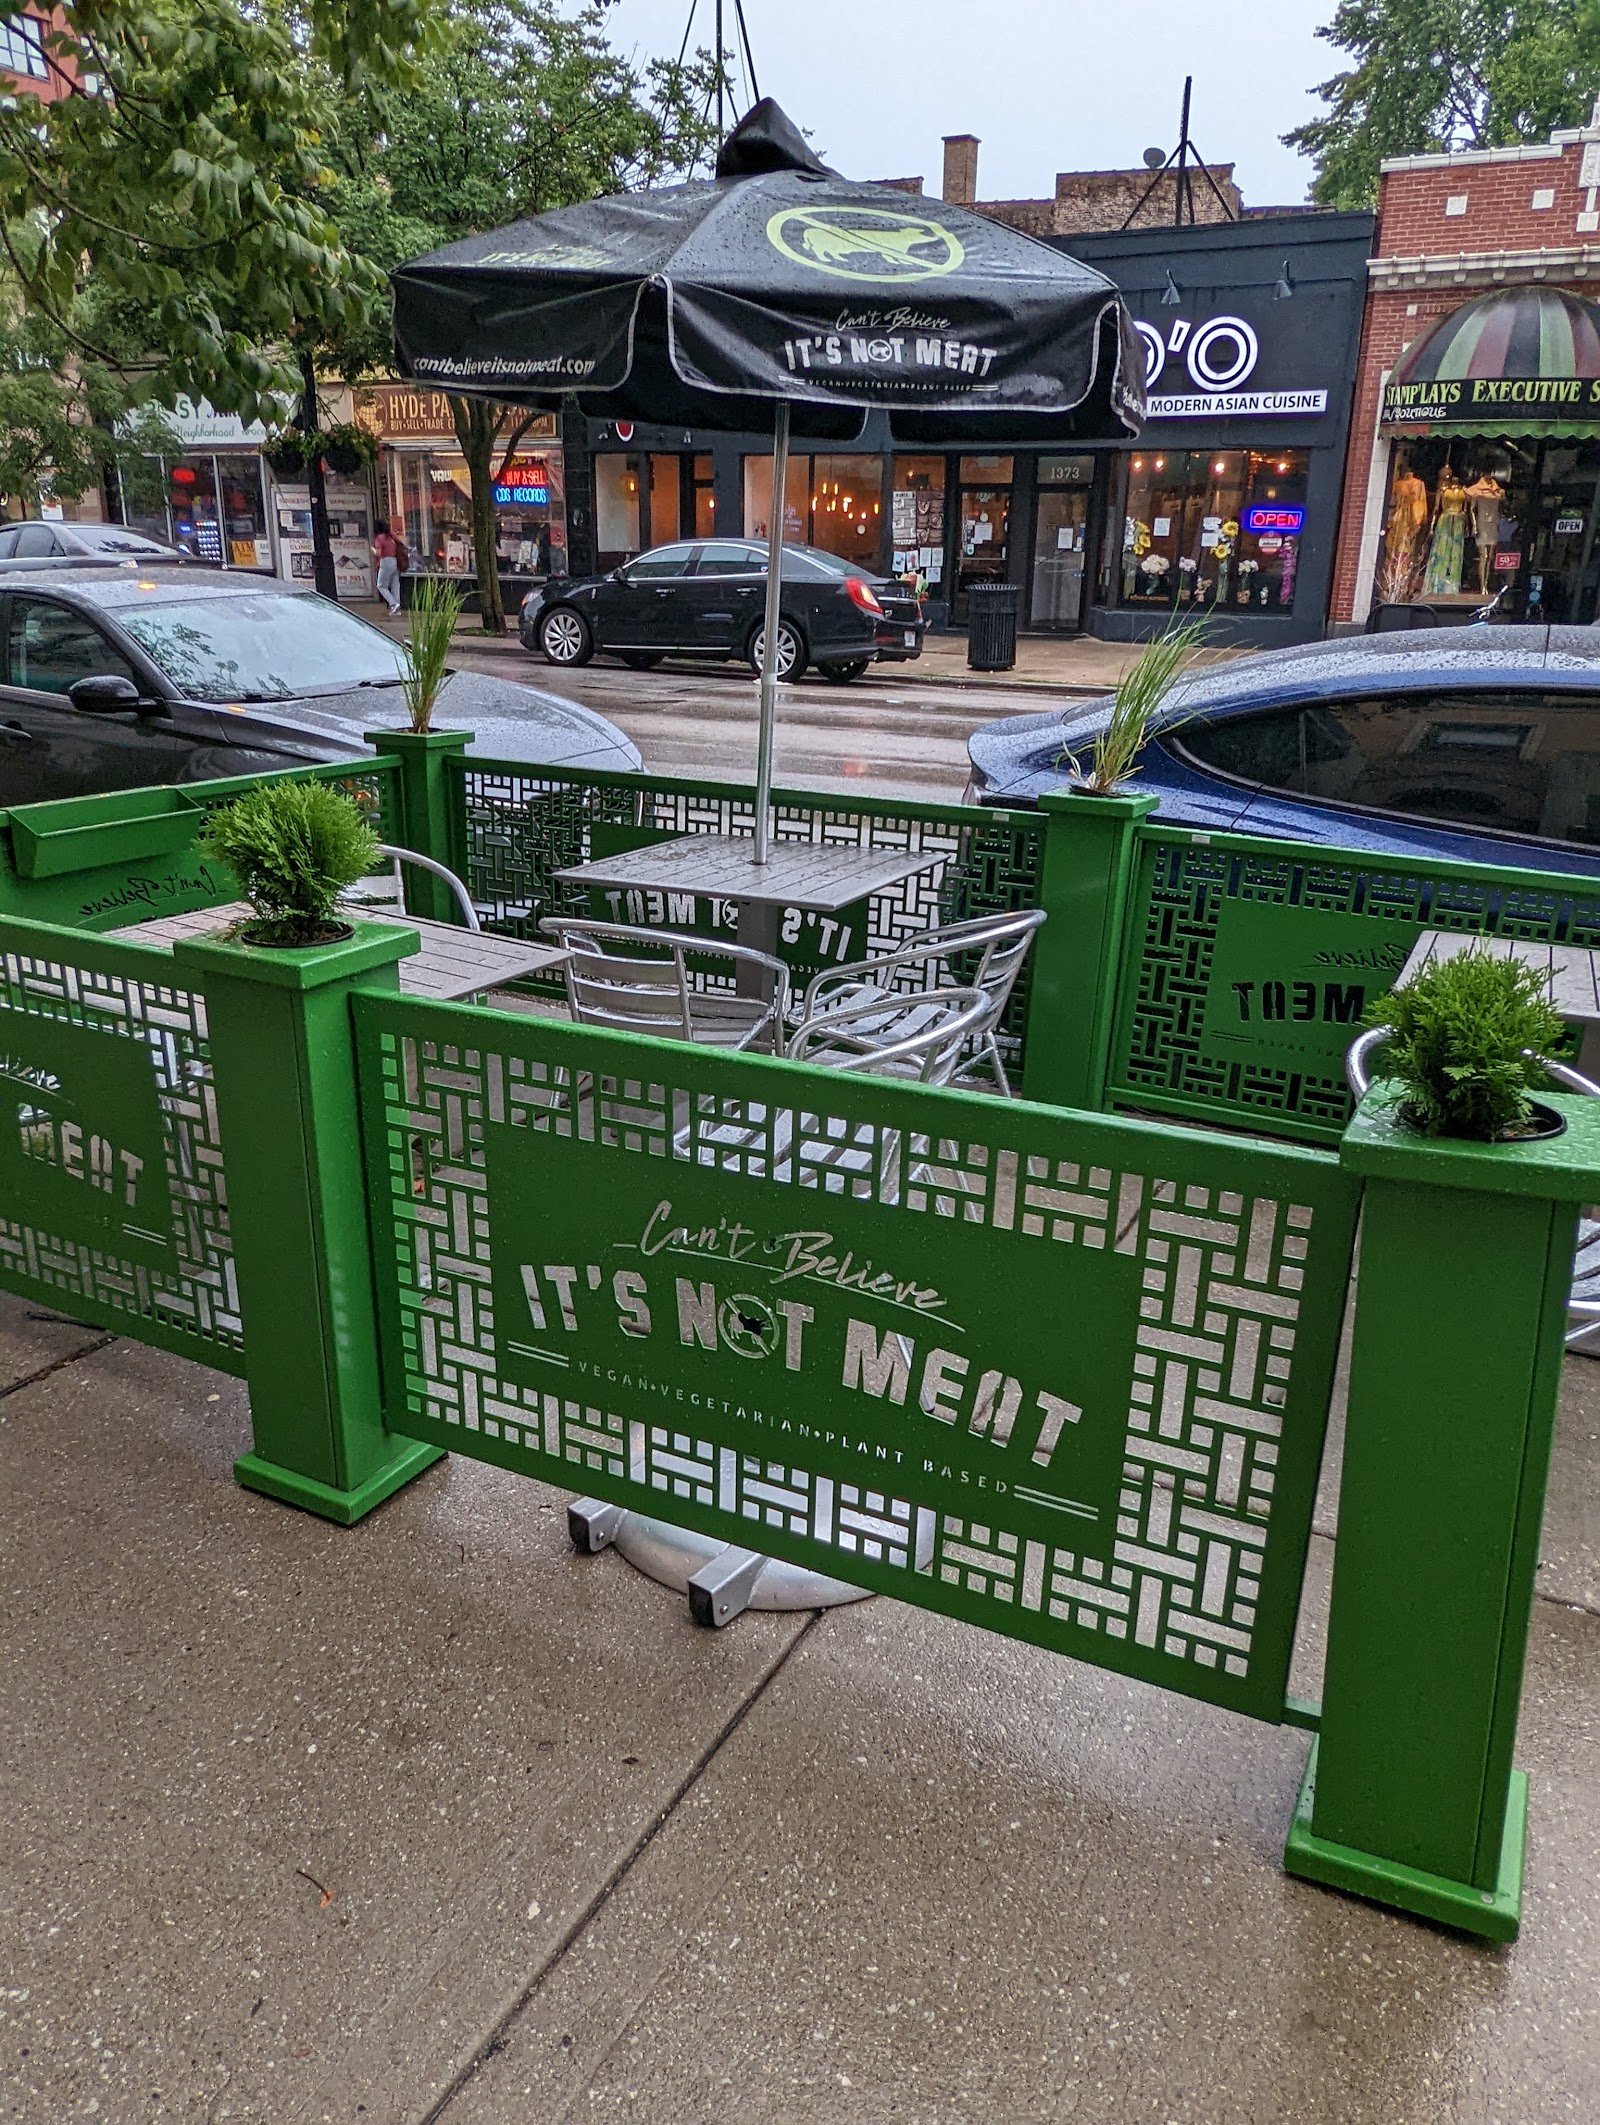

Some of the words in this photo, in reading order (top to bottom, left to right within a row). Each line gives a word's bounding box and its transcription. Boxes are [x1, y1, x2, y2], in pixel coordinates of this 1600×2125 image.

[836, 307, 881, 332] Can't
[884, 306, 952, 333] Believe
[414, 356, 596, 376] cantbelieveitsnotmeat.com
[784, 337, 843, 371] IT'S
[915, 338, 998, 377] MEAT
[1472, 379, 1582, 403] EXECUTIVE
[389, 394, 427, 419] HYDE
[1150, 398, 1213, 412] MODERN
[1215, 397, 1259, 411] ASIAN
[1262, 395, 1322, 409] CUISINE
[506, 471, 521, 486] BUY
[1050, 467, 1080, 479] 1373
[513, 488, 547, 503] RECORDS
[1254, 513, 1298, 526] OPEN
[1557, 521, 1580, 531] OPEN
[234, 541, 255, 553] ATM
[18, 1102, 145, 1208] MEAT
[640, 1200, 755, 1257] Can't
[770, 1231, 949, 1310] Believe
[520, 1264, 652, 1338] IT'S
[675, 1276, 816, 1372] NOT
[841, 1318, 1083, 1468] MEAT
[922, 1457, 1008, 1495] BASED
